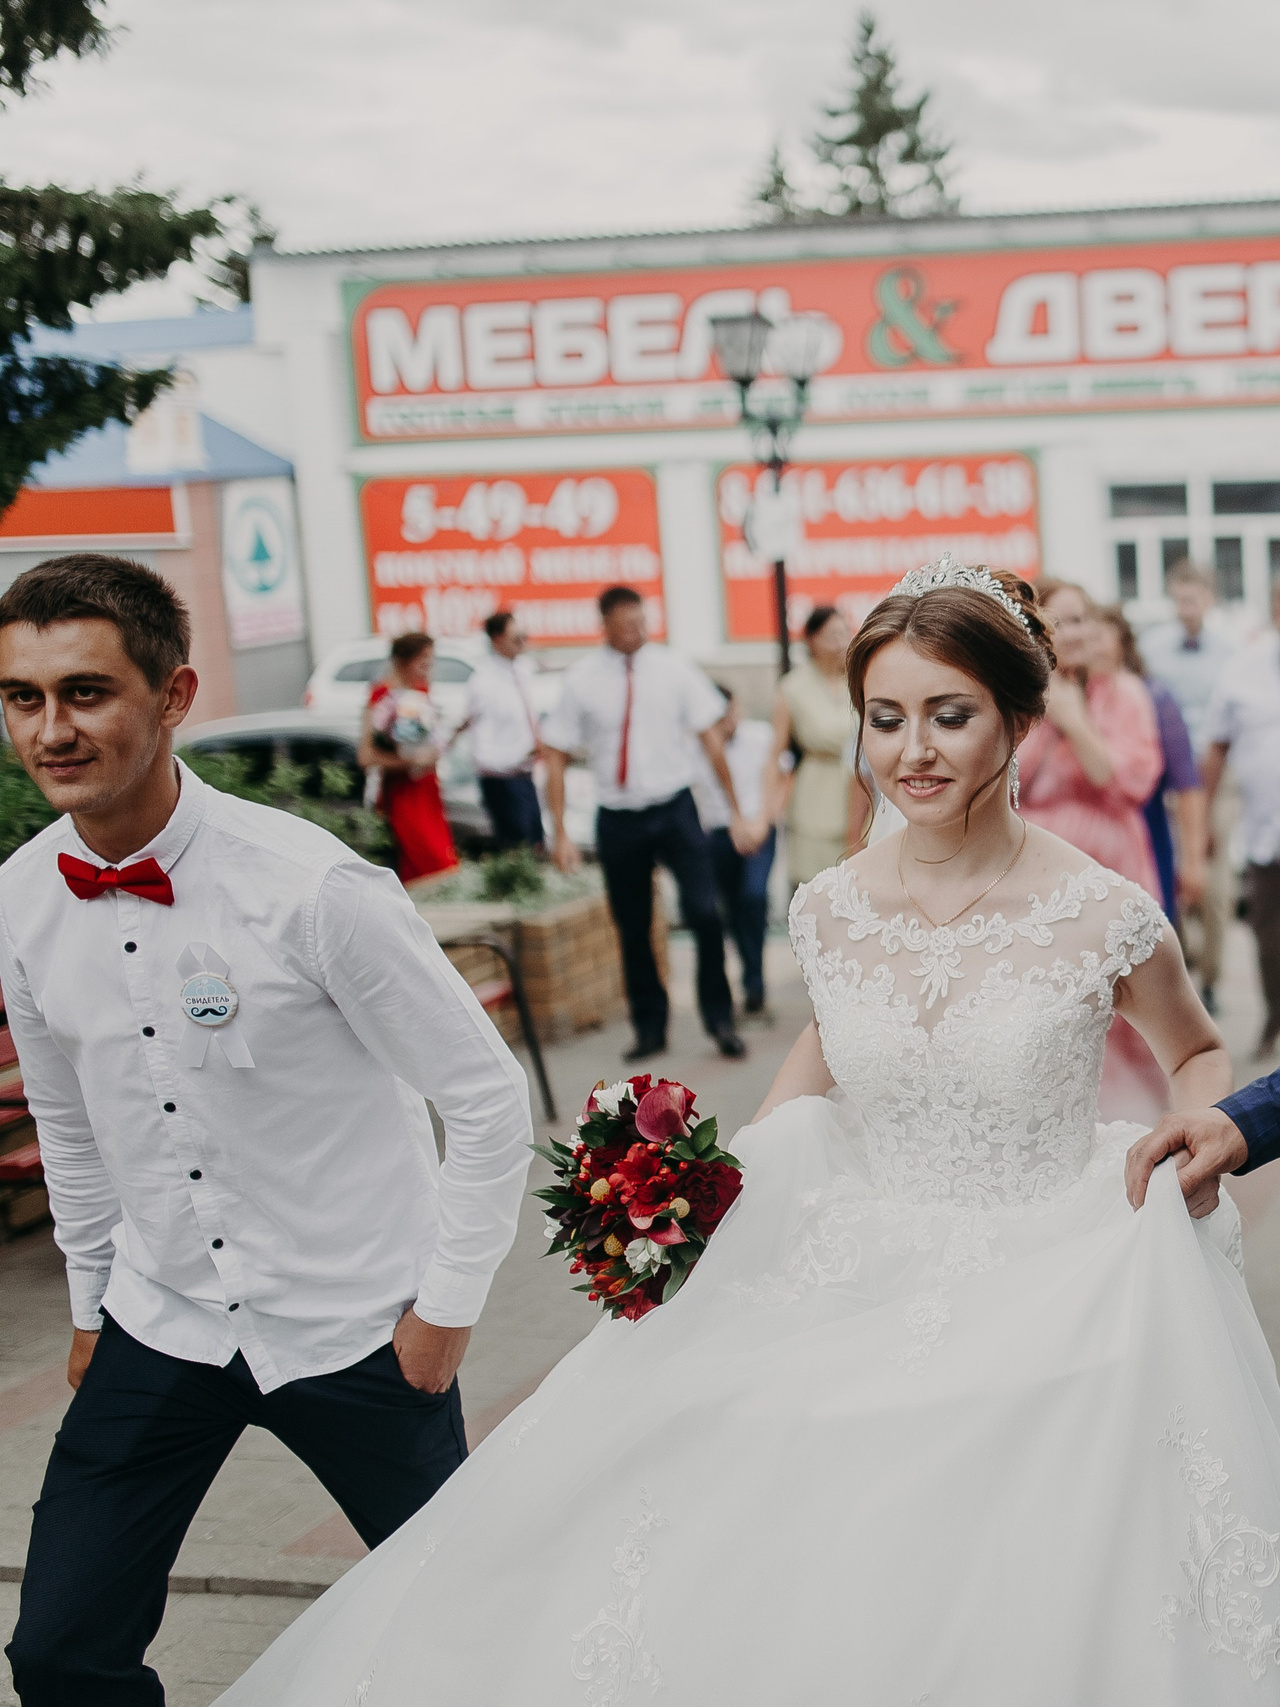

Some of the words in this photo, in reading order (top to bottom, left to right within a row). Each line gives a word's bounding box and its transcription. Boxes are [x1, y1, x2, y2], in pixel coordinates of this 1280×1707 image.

[866, 261, 962, 367] &
[400, 476, 619, 543] 5-49-49
[185, 995, 230, 1005] СВИДЕТЕЛЬ
